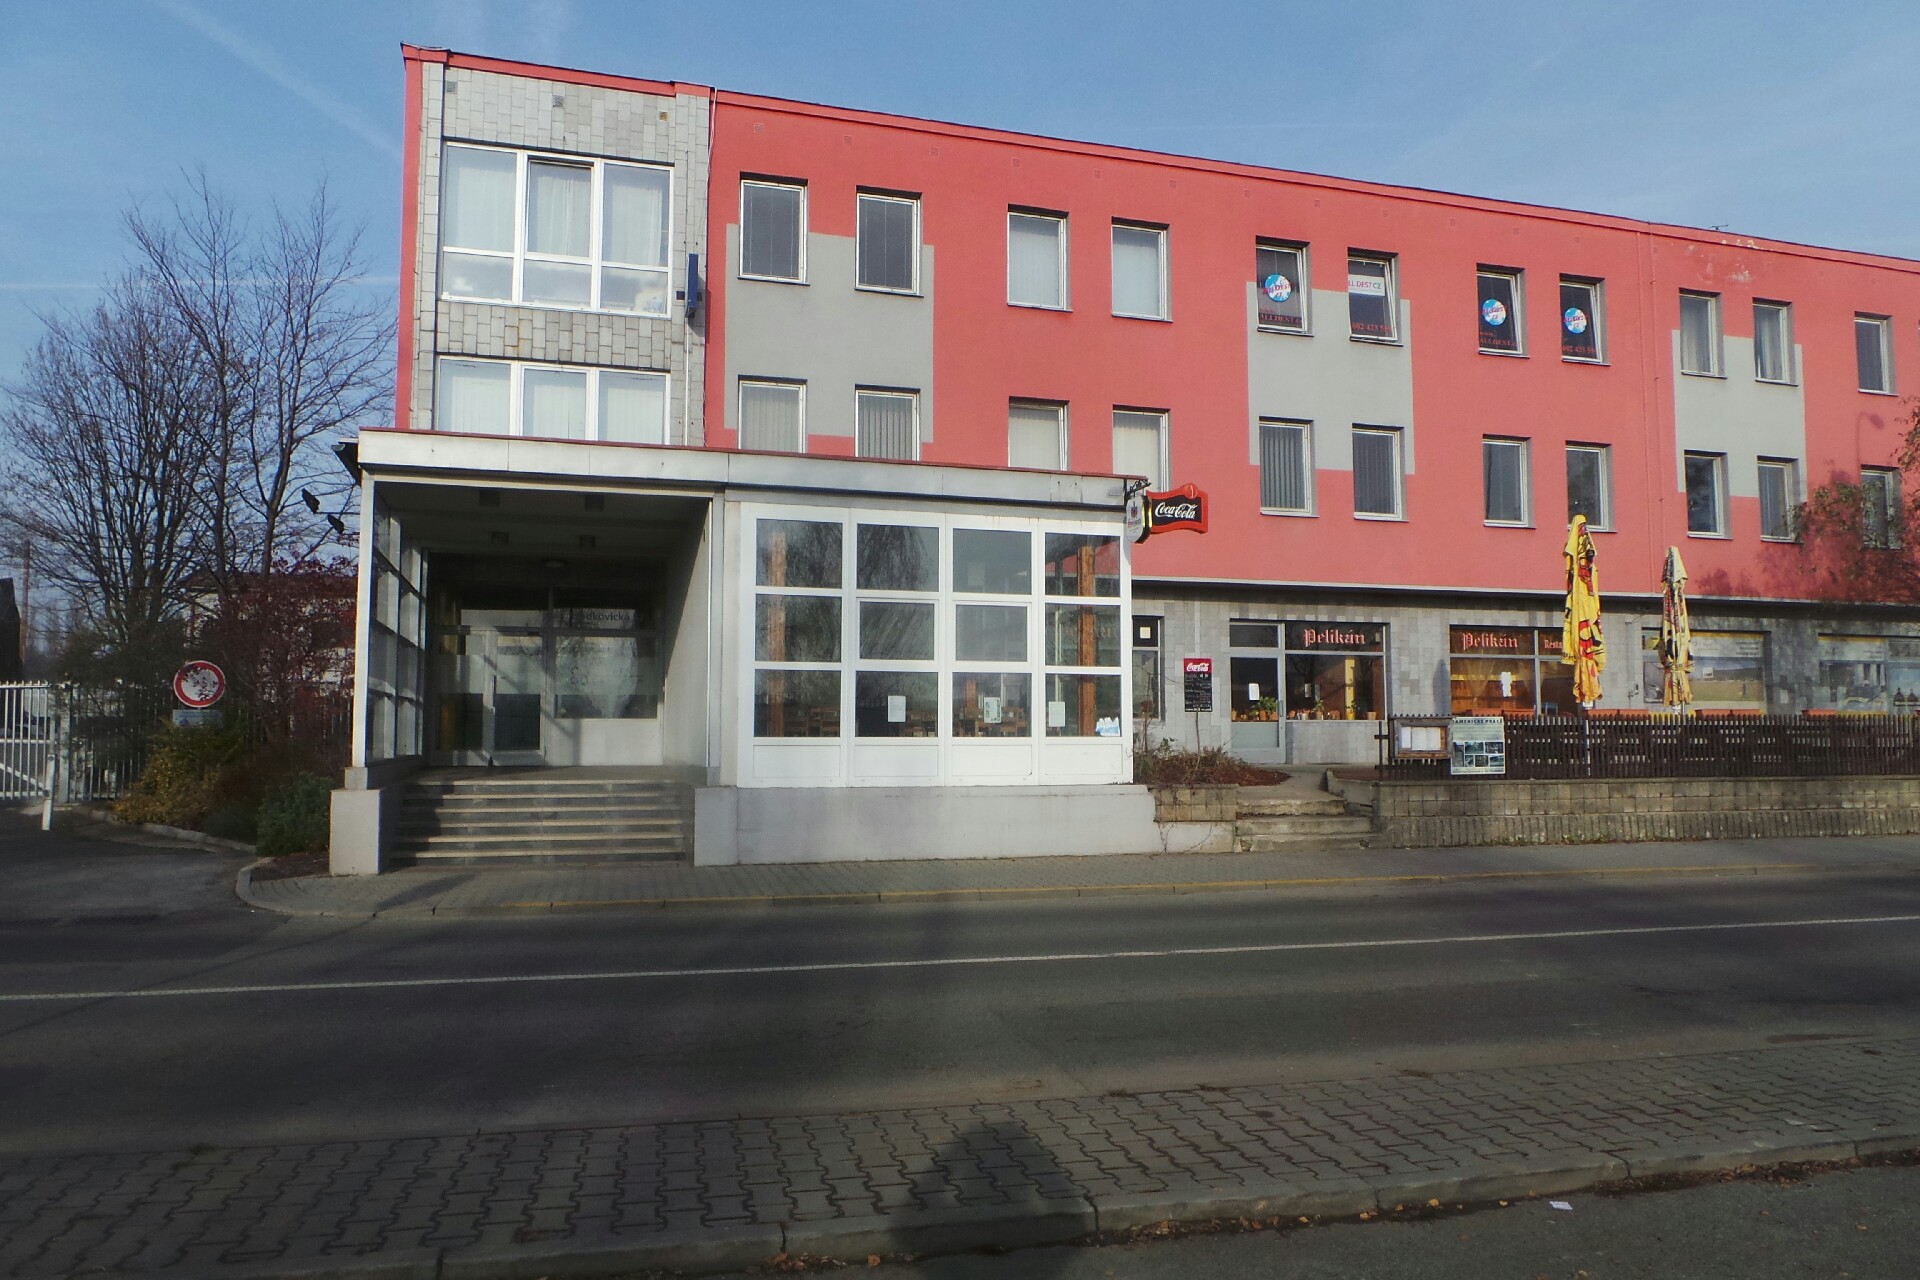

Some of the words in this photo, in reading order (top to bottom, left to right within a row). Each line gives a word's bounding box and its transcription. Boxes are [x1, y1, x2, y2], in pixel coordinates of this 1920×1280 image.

[1155, 502, 1198, 519] Coca-Cola
[1303, 629, 1366, 648] Pelikán
[1461, 632, 1518, 650] Pelikán
[1544, 640, 1563, 649] Resta
